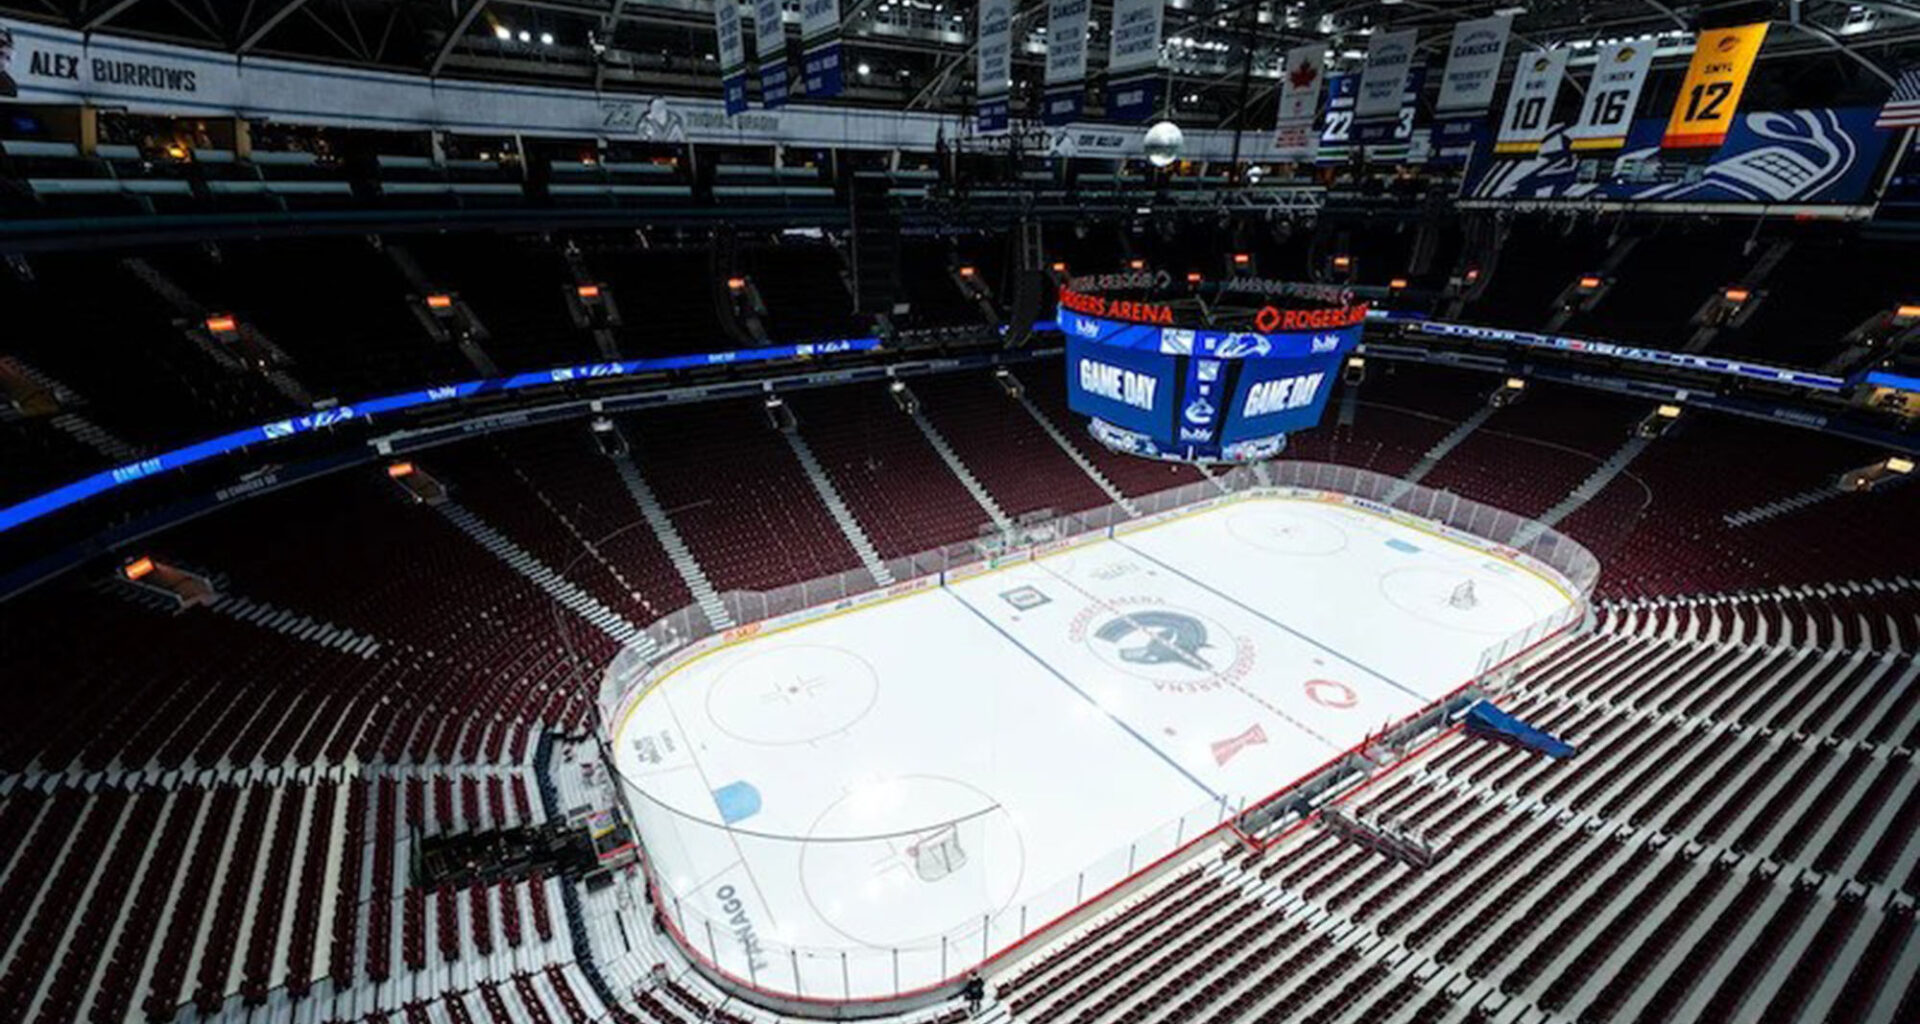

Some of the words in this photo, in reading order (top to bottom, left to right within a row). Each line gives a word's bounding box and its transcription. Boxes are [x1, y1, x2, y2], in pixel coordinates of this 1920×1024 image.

[1454, 41, 1501, 58] CANUCKS
[30, 50, 80, 80] ALEX
[92, 59, 197, 92] BURROWS
[1512, 97, 1546, 131] 10
[1591, 90, 1631, 125] 16
[1684, 81, 1734, 122] 12
[1322, 111, 1354, 141] 22
[1394, 107, 1416, 138] 3
[1108, 299, 1175, 325] ARENA
[1283, 308, 1348, 330] ROGERS
[1079, 358, 1124, 400] GAME
[1123, 373, 1157, 411] DAY
[1243, 380, 1289, 418] GAME
[1287, 371, 1326, 408] DAY
